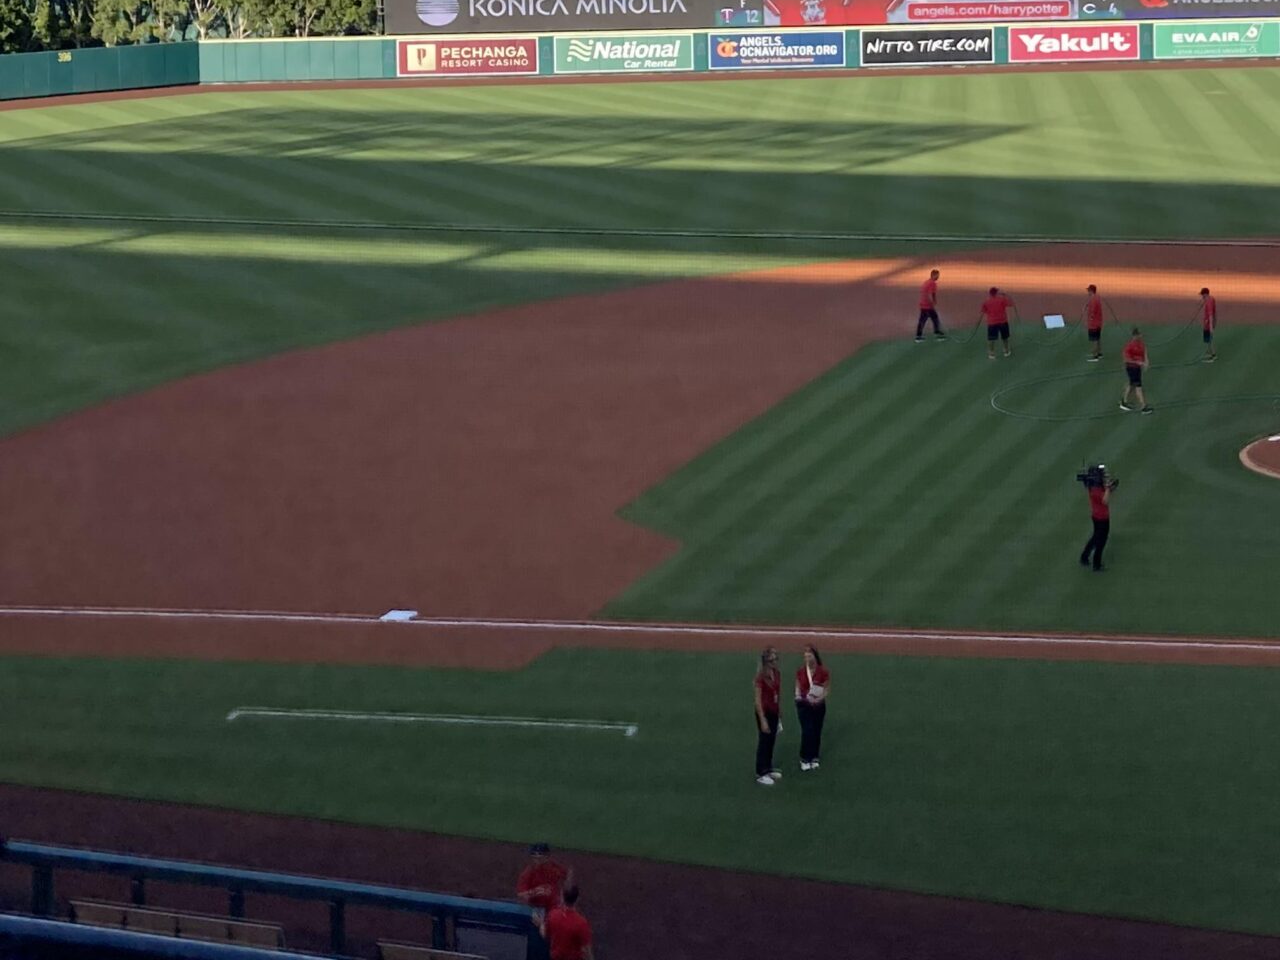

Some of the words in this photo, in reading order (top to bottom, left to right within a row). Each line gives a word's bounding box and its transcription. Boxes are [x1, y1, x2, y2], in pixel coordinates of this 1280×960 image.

[913, 3, 1064, 19] angels.com/harrypotter
[1108, 3, 1118, 15] 4
[745, 9, 759, 23] 12
[866, 38, 914, 54] NITTO
[917, 36, 990, 53] TIRE.COM
[1018, 32, 1131, 53] Yakult
[440, 46, 528, 59] PECHANGA
[592, 40, 680, 60] National
[740, 45, 838, 57] OCNAVIGATOR.ORG
[441, 59, 483, 68] RESORT
[488, 58, 529, 67] CASINO
[623, 60, 641, 69] Car
[644, 59, 677, 68] Rental
